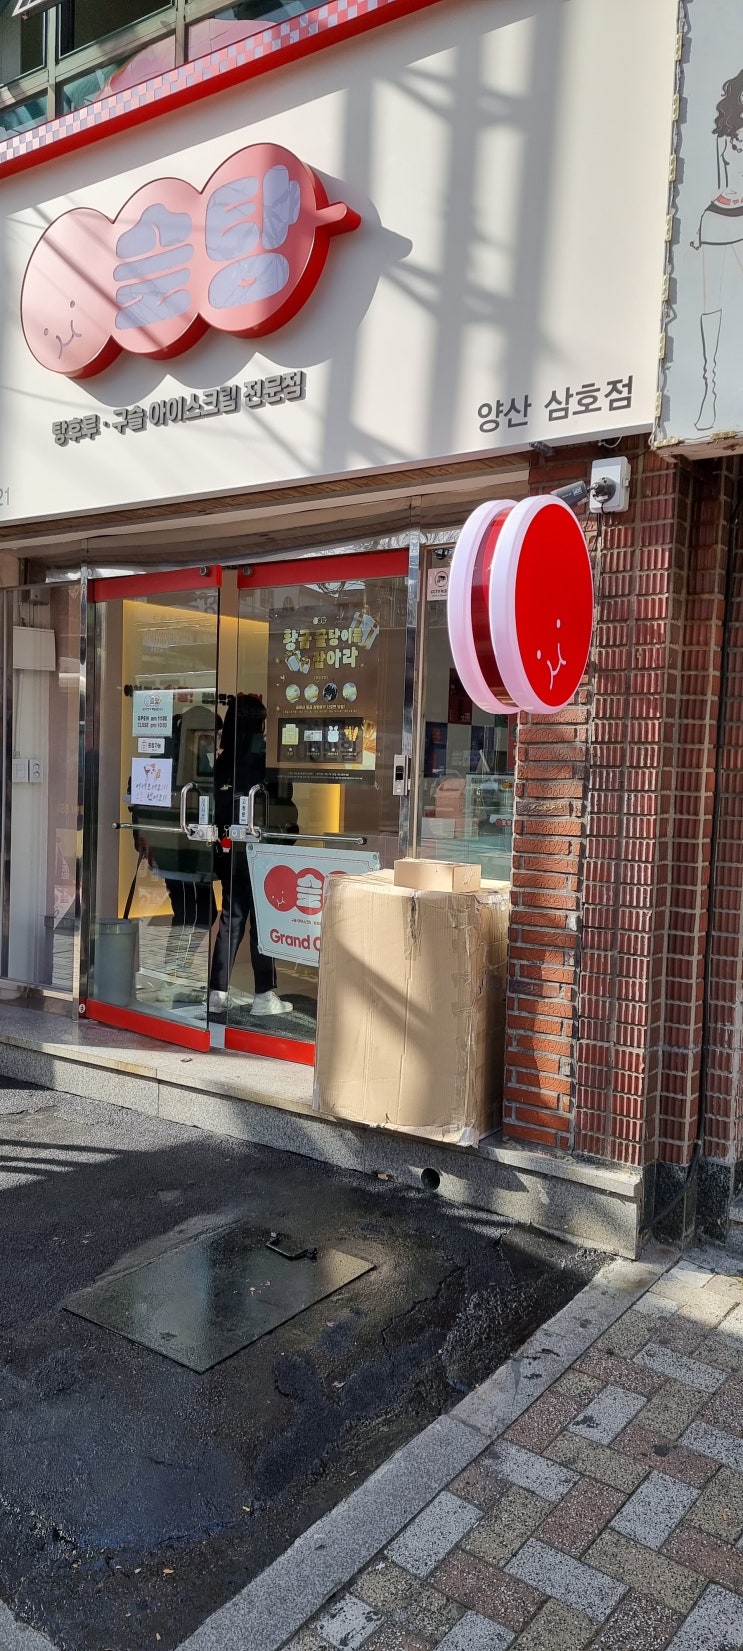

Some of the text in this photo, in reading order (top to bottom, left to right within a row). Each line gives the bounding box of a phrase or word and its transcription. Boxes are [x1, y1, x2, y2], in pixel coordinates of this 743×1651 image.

[52, 370, 307, 446] 탕후루 구슬 아이스크림 전문점
[477, 374, 634, 434] 양산 삼호점
[296, 874, 323, 909] 슬
[270, 928, 311, 950] Grand
